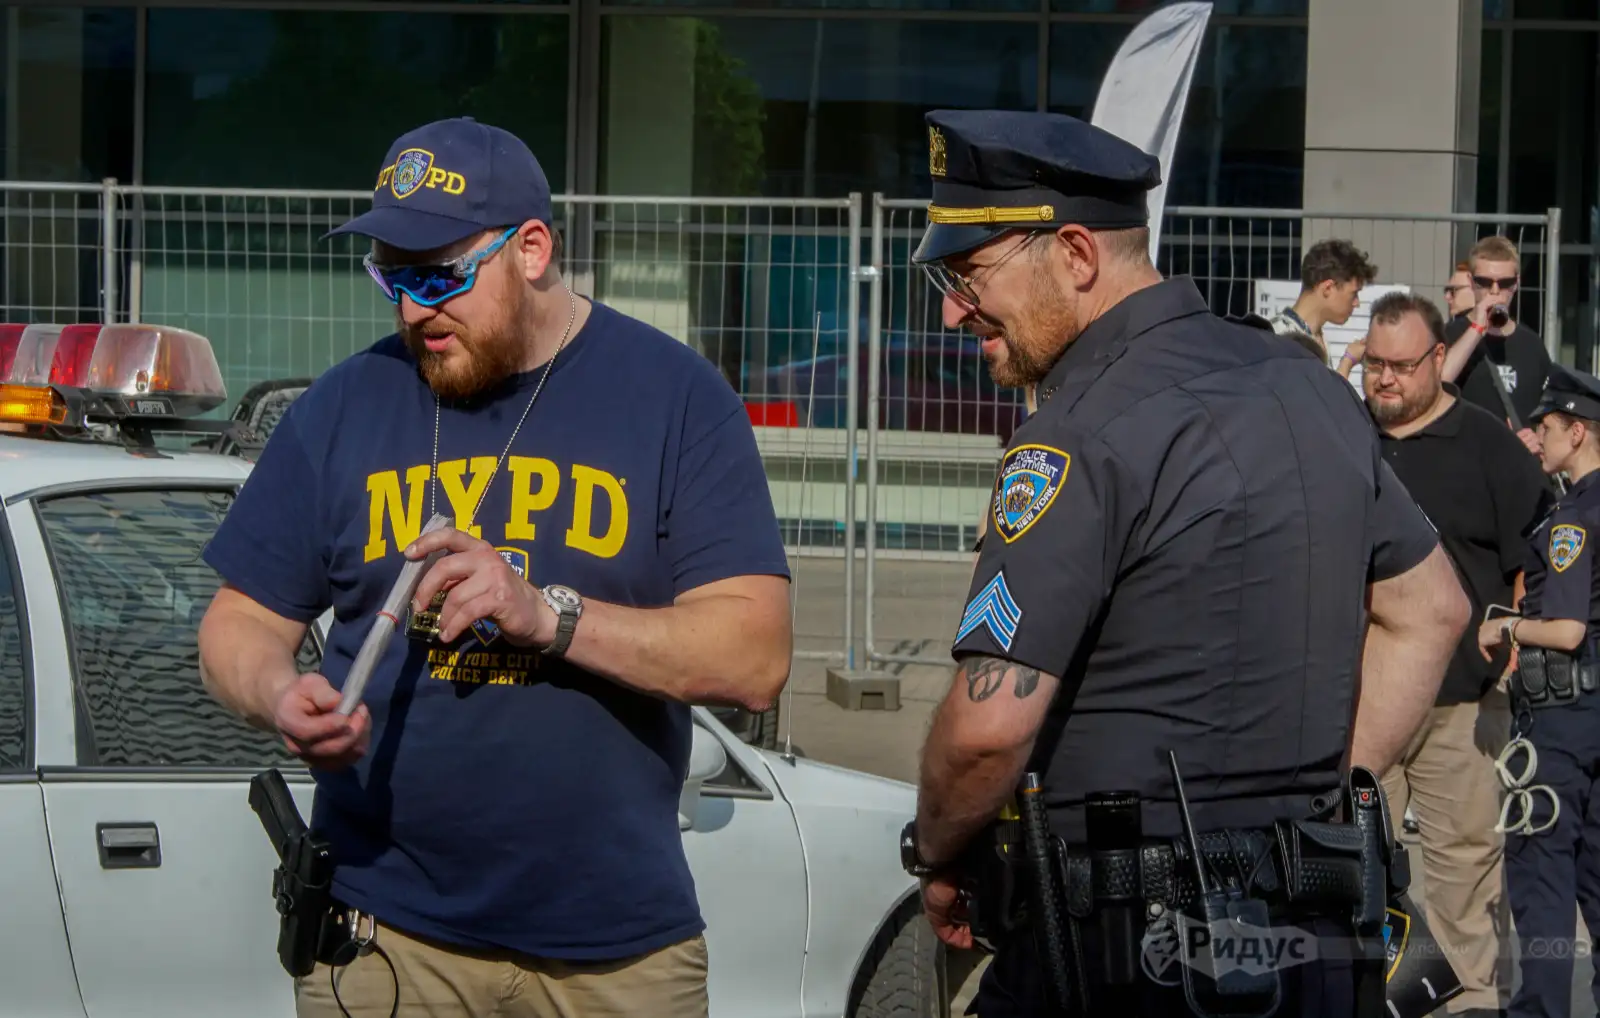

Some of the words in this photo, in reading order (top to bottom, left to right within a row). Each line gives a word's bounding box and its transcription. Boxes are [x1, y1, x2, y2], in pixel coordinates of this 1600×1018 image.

[1015, 450, 1048, 463] POLICE
[1002, 459, 1058, 479] DEPARTMENT
[1015, 512, 1034, 531] NEW
[1034, 485, 1056, 512] YORK
[427, 649, 459, 667] NEW
[464, 652, 499, 667] YORK
[506, 653, 541, 670] CITY
[430, 665, 480, 683] POLICE
